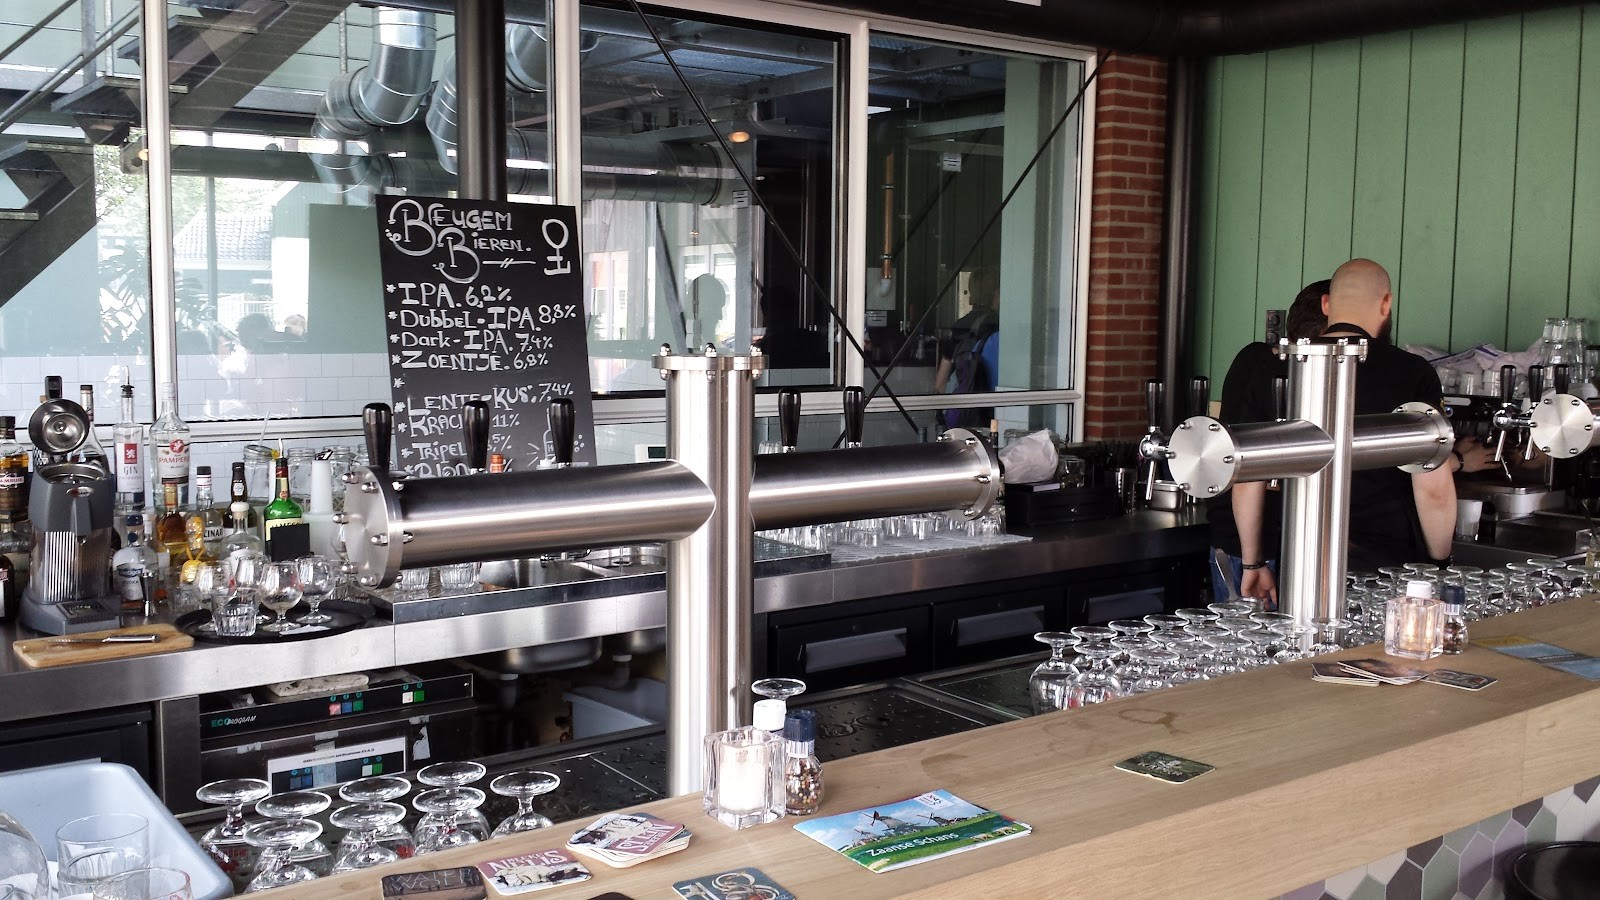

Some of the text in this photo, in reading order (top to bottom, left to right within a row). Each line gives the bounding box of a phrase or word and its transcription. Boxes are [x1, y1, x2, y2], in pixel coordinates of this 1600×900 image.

[398, 283, 512, 309] IPA. 6,2%
[515, 333, 553, 352] 7,4%
[513, 353, 549, 370] 6,8%
[158, 454, 190, 464] PAMPER
[123, 466, 139, 475] GIN
[203, 527, 224, 539] LINAR
[866, 832, 959, 857] Zaanse Schans
